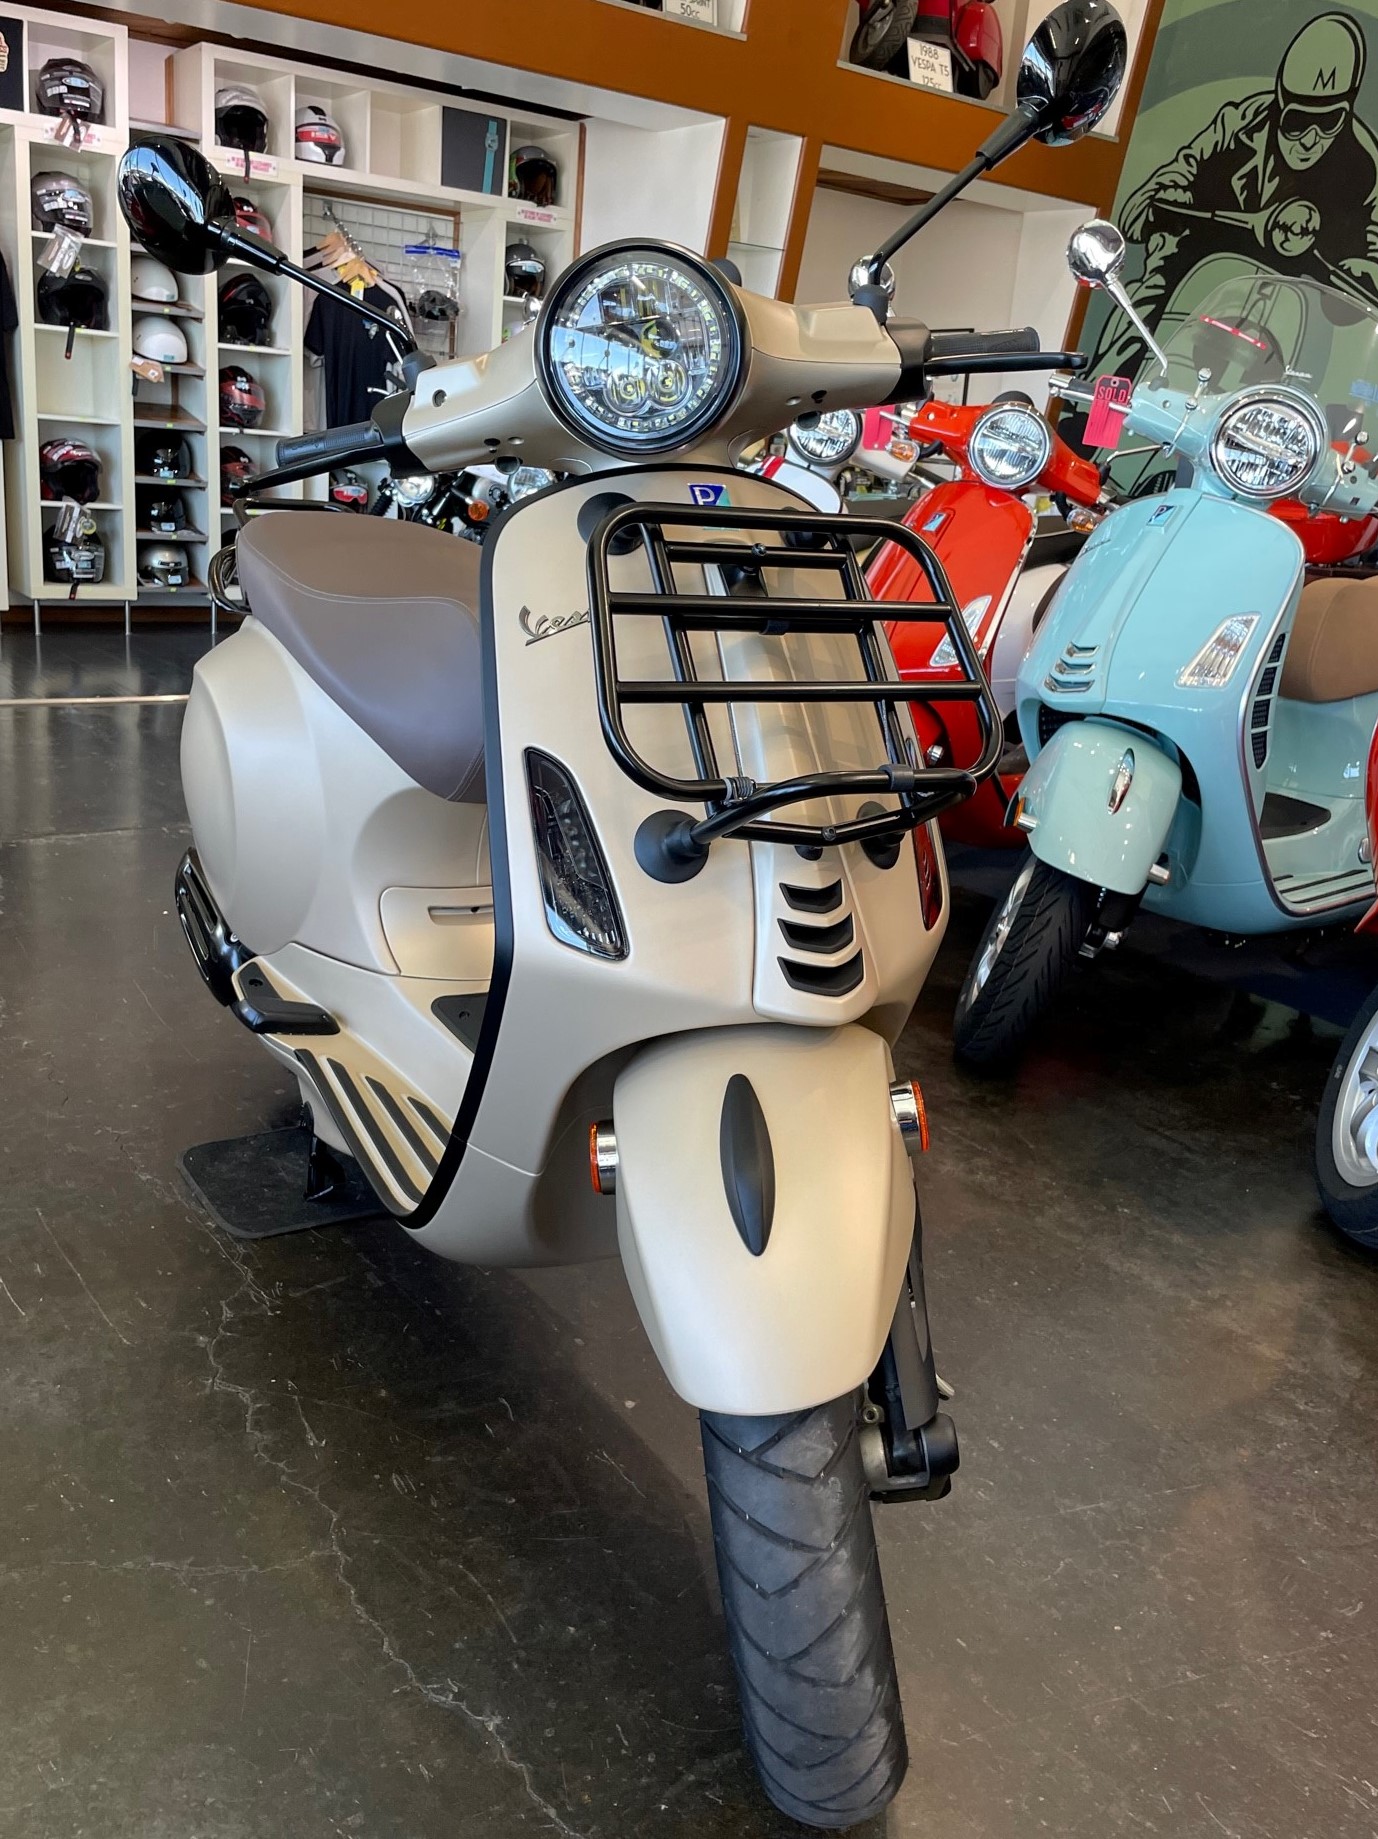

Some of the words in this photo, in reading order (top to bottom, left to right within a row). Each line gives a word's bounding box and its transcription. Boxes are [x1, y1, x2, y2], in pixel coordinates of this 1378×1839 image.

[920, 43, 939, 60] 1988
[911, 55, 937, 74] VESPA
[1312, 66, 1336, 91] M
[1097, 386, 1127, 402] SOLD
